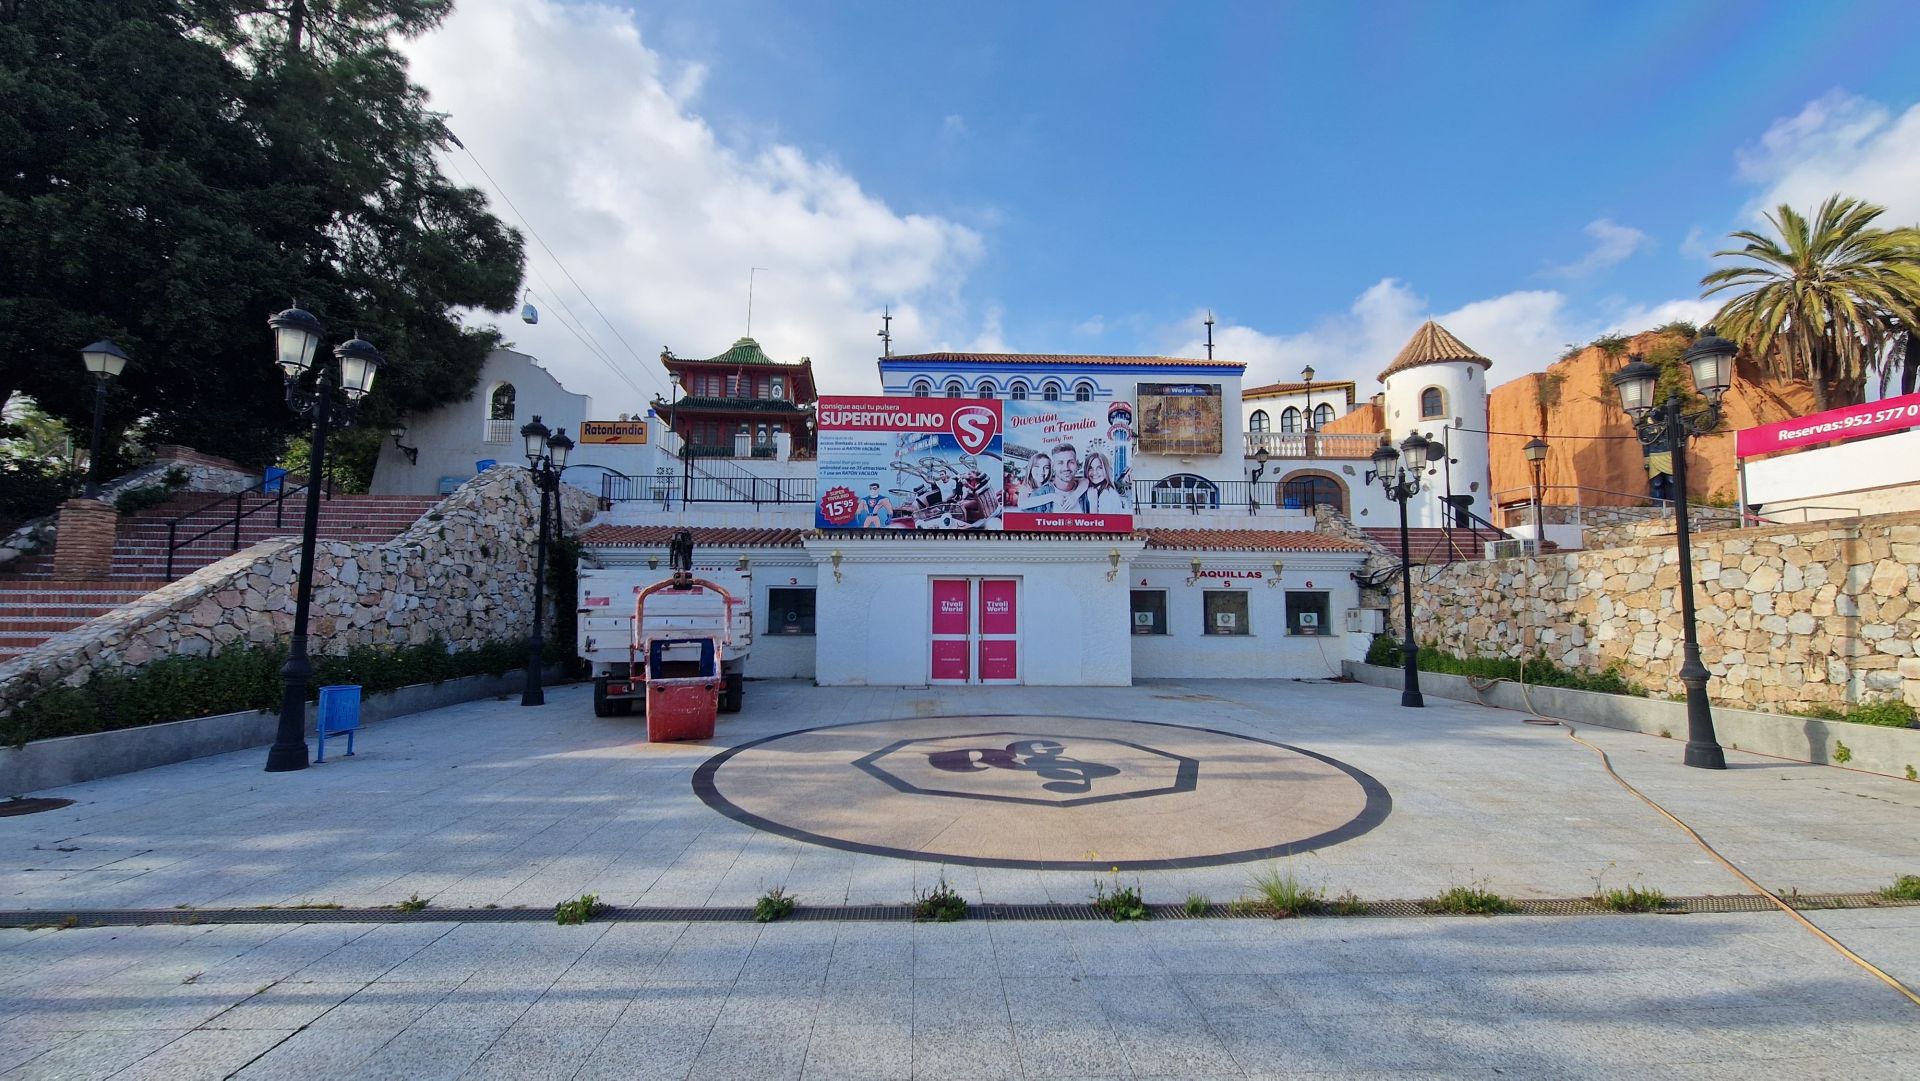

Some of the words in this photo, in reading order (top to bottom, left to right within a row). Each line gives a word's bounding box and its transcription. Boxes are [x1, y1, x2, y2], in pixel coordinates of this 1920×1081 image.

[821, 411, 944, 427] SUPERTIVOLINO
[1011, 412, 1058, 428] Diversión
[1044, 424, 1055, 433] en
[1057, 419, 1097, 432] Familia
[1778, 420, 1844, 441] Reservas:
[1844, 413, 1872, 428] 952
[1874, 406, 1904, 422] 577
[1907, 404, 1920, 416] 0
[584, 424, 643, 435] Ratonlandia
